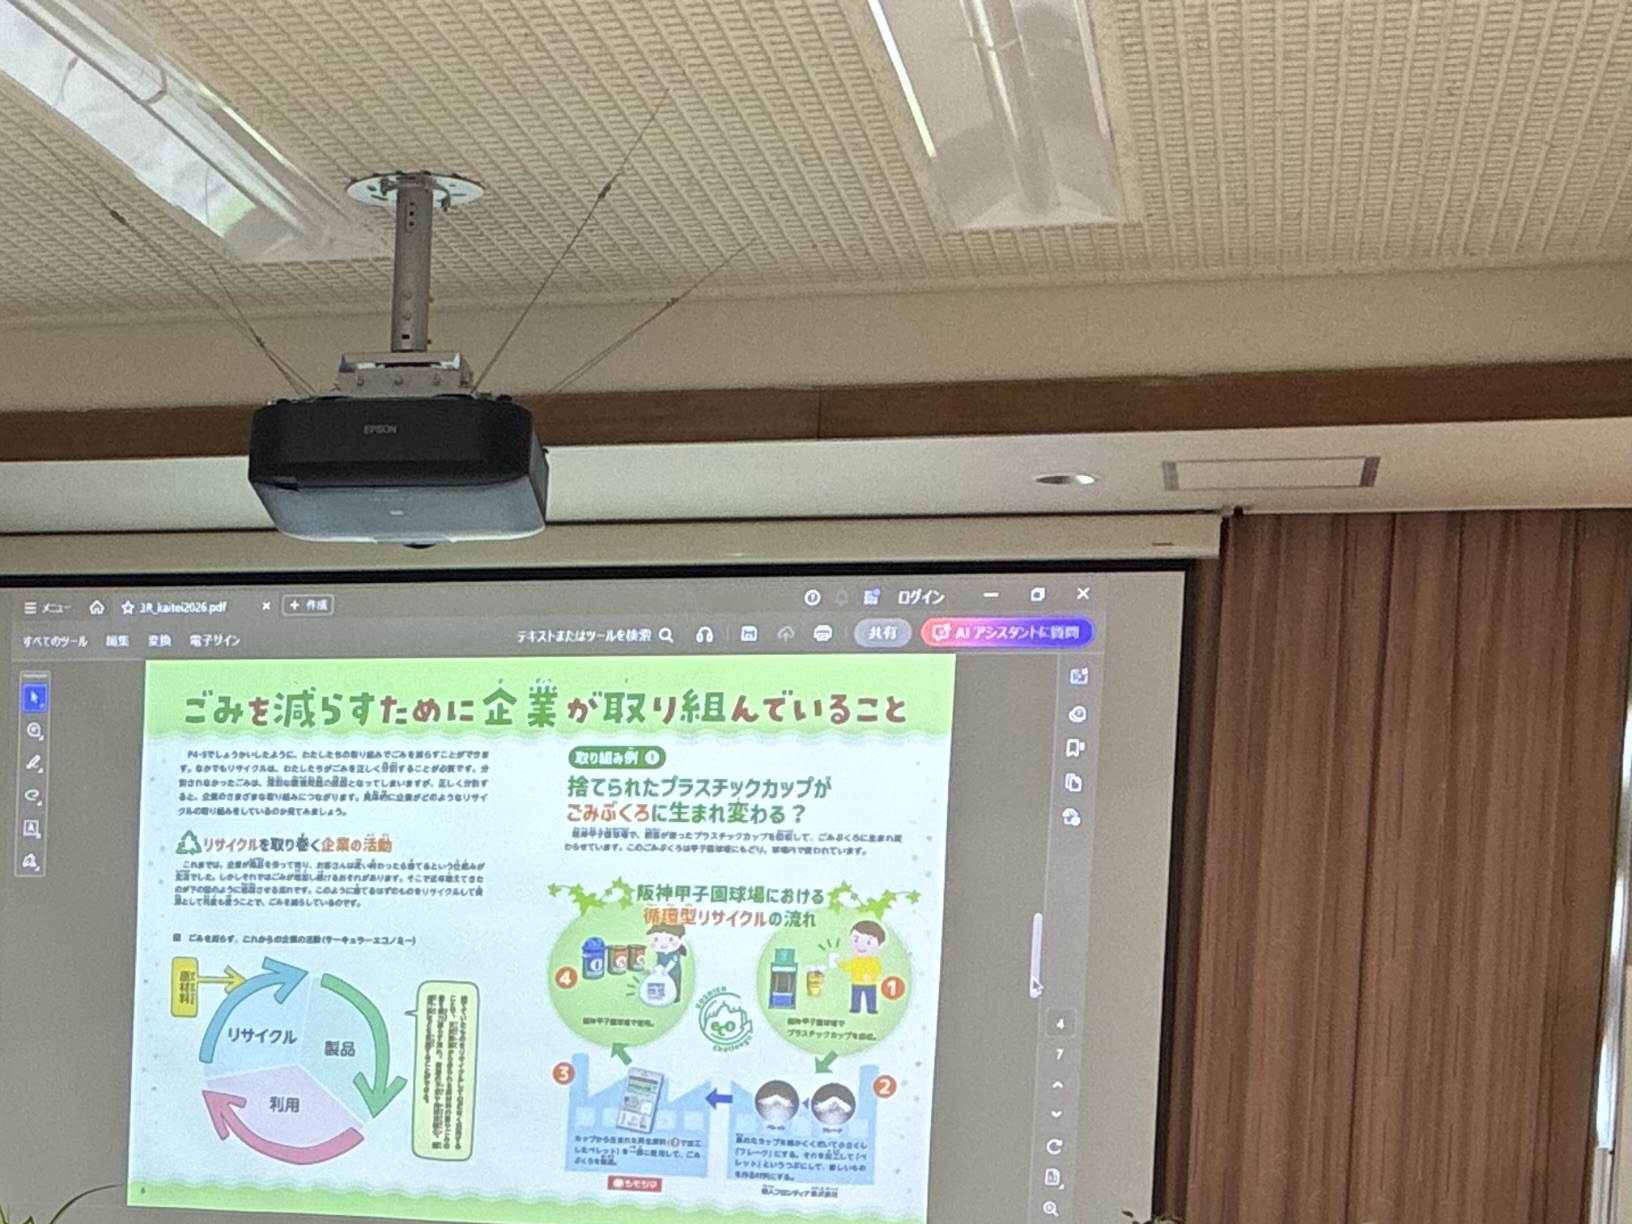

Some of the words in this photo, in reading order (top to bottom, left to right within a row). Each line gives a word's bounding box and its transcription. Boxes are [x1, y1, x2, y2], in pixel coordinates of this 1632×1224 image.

[363, 424, 397, 434] EPSON
[306, 599, 329, 611] 作成
[897, 590, 945, 606] ログイン
[41, 602, 72, 614] メニュー
[517, 627, 652, 644] テキストまたはツールを検索
[868, 624, 898, 640] 共有
[955, 626, 970, 640] AI
[23, 635, 88, 648] すべてのツール
[105, 634, 130, 648] 編集
[148, 634, 172, 648] 変換
[189, 634, 241, 648] 電子サイン
[185, 684, 907, 729] ごみを減らすために企業が取り組んでいること
[567, 775, 833, 799] 捨てられたプラスチックカップが
[203, 836, 393, 853] リサイクルを取り巻く企業の活動
[636, 884, 825, 905] 阪神甲子園球場における
[1055, 1018, 1065, 1030] 4
[226, 1027, 298, 1046] リサイクル
[324, 1040, 356, 1058] 製品
[1056, 1048, 1064, 1061] 7
[269, 1096, 300, 1114] 利用
